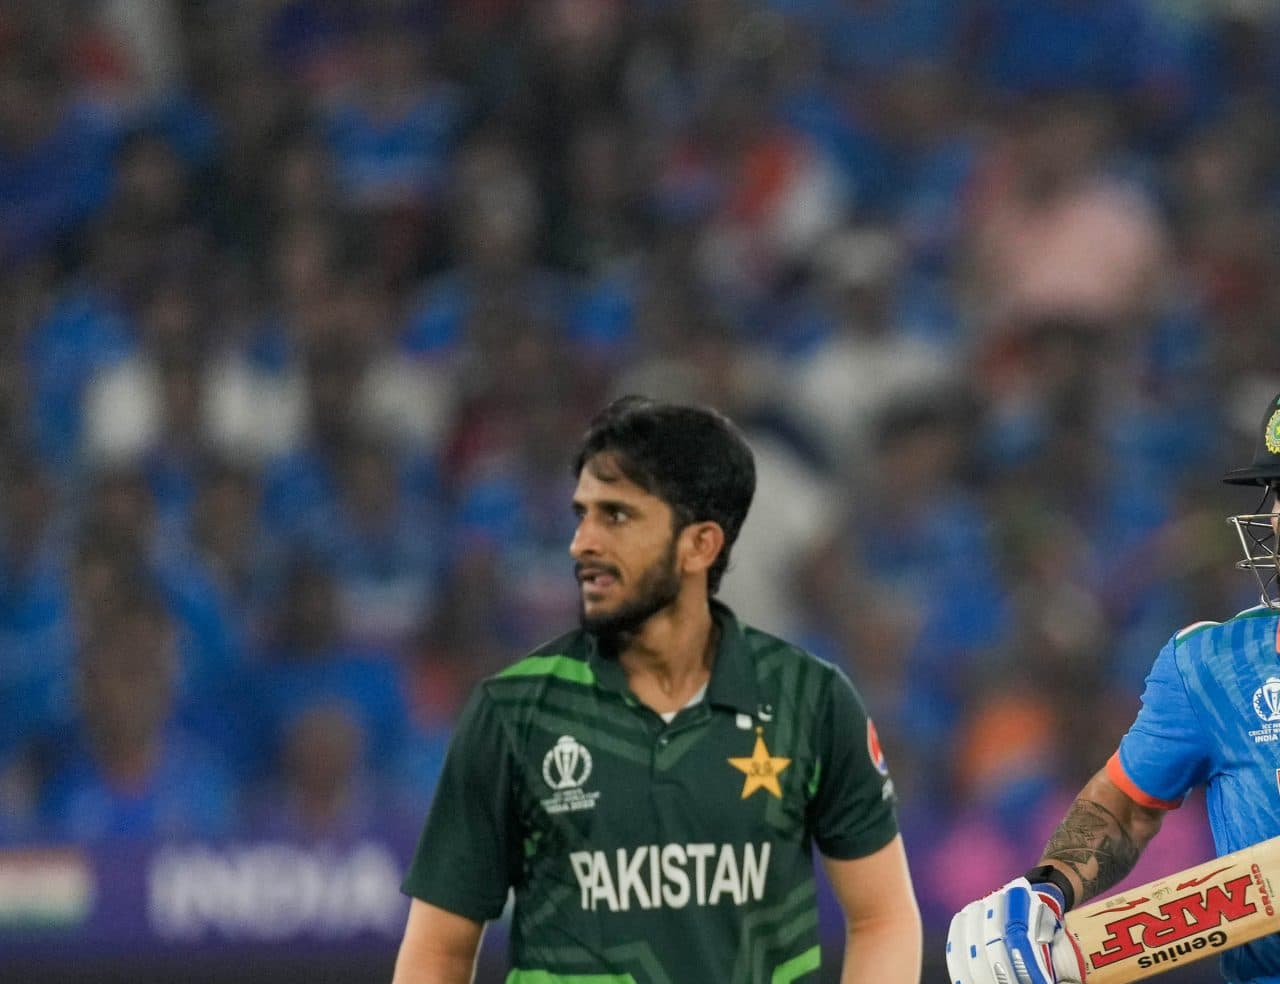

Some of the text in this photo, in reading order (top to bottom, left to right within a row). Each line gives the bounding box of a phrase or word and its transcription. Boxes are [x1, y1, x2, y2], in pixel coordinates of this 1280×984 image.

[569, 841, 771, 912] PAKISTAN
[1089, 874, 1258, 970] MRF
[1137, 930, 1228, 969] Genius
